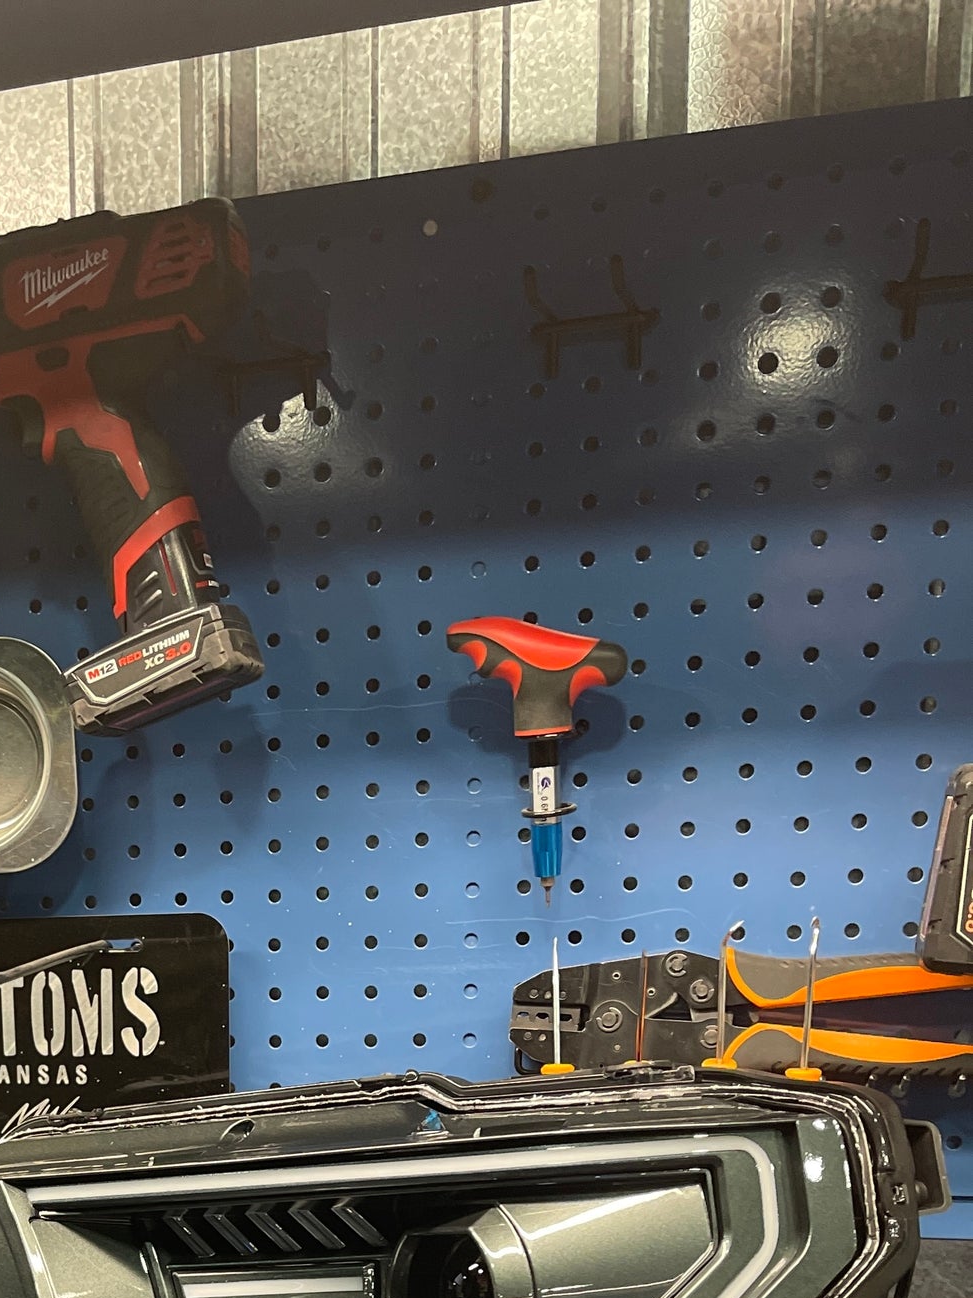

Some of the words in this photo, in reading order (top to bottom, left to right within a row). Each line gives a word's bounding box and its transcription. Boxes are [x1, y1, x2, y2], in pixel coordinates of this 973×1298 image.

[19, 248, 109, 304] Milwaukee
[87, 661, 117, 680] M12
[117, 629, 191, 668] REDLITHIUM
